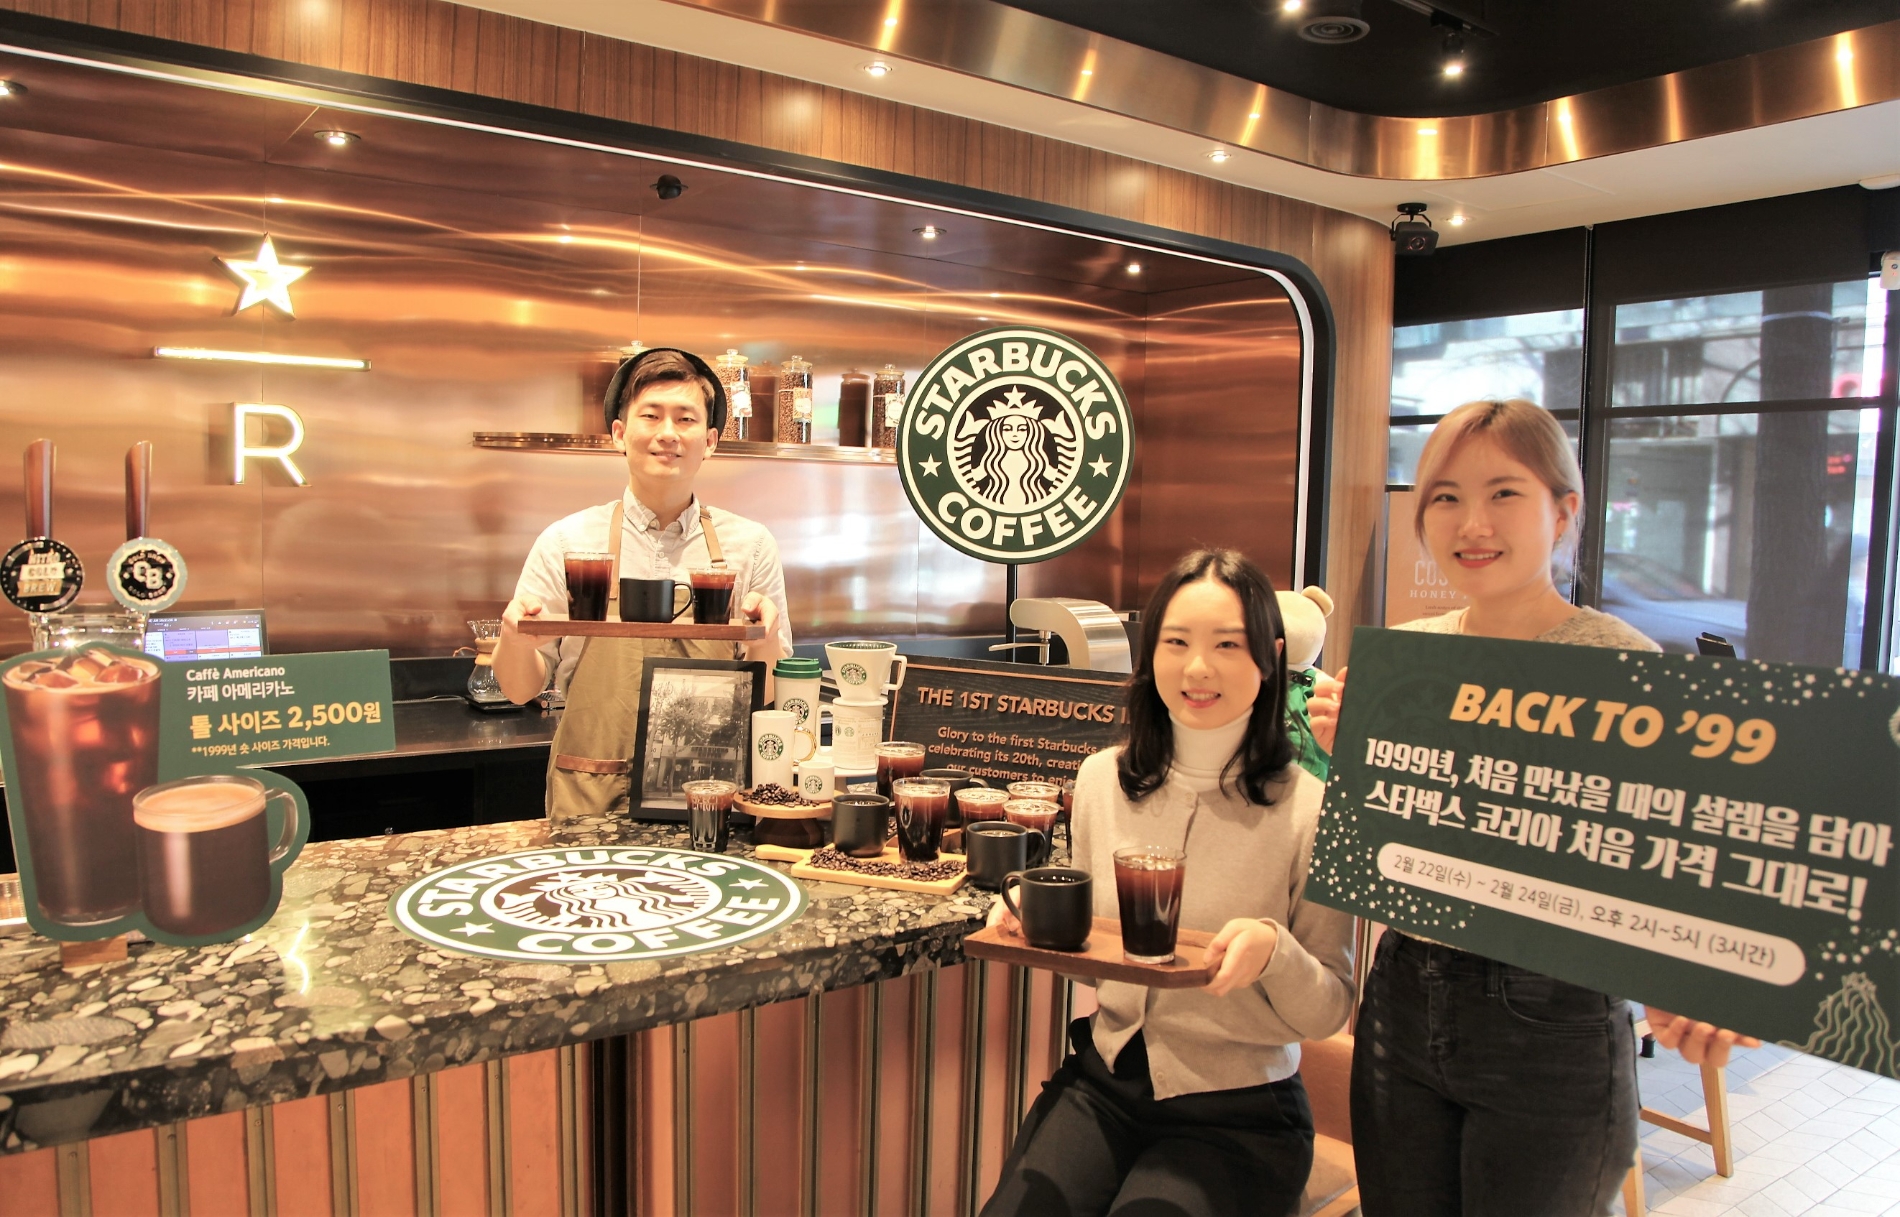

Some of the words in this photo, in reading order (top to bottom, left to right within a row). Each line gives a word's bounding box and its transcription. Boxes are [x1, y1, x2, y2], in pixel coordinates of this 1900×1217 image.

[915, 341, 1117, 440] STARBUCKS
[233, 402, 309, 485] R
[938, 485, 1098, 546] COFFEE
[23, 582, 57, 593] BREW
[133, 560, 164, 590] CB
[1409, 589, 1456, 599] HONEY
[186, 667, 220, 682] Caffè
[223, 666, 285, 680] Americano
[187, 686, 219, 703] 카페
[222, 682, 295, 699] 아메리카노
[190, 715, 212, 739] 톨
[218, 711, 282, 736] 사이즈
[287, 702, 381, 732] 2,500원
[918, 686, 954, 707] THE
[960, 691, 993, 711] 1ST
[996, 695, 1115, 723] STARBUCKS
[1449, 682, 1587, 738] BACK
[1592, 700, 1664, 748] TO
[252, 739, 281, 752] 사이즈
[283, 736, 330, 750] 가격입니다.
[928, 743, 991, 763] celebrating
[994, 749, 1009, 762] its
[1012, 752, 1043, 768] 20th,
[1046, 757, 1082, 771] creati
[938, 726, 970, 743] Glory
[971, 731, 985, 742] to
[988, 732, 1007, 745] the
[1010, 734, 1034, 748] first
[1037, 737, 1098, 755] Starbucks
[946, 763, 966, 772] our
[968, 766, 1029, 782] customers
[1031, 772, 1045, 783] to
[1048, 776, 1077, 787] enj
[1365, 738, 1459, 788] 1999년,
[1464, 754, 1519, 795] 처음
[1523, 765, 1612, 813] 만났을
[1616, 781, 1687, 827] 때의
[1691, 793, 1800, 850] 설렘을
[1808, 813, 1894, 867] 담아
[1364, 780, 1466, 827] 스타벅스
[1470, 802, 1563, 853] 코리아
[1566, 819, 1635, 870] 처음
[1640, 835, 1718, 888] 가격
[1722, 852, 1868, 922] 그대로!
[416, 850, 742, 917] STARBUCKS
[517, 895, 781, 955] COFFEE
[1394, 854, 1415, 874] 2월
[1418, 860, 1472, 889] 22일(수)
[1490, 879, 1514, 900] 2월
[1519, 887, 1584, 922] 24일(금),
[1590, 904, 1623, 928] 오후
[1630, 914, 1701, 950] 2시~5시
[1707, 934, 1776, 969] (3시간)
